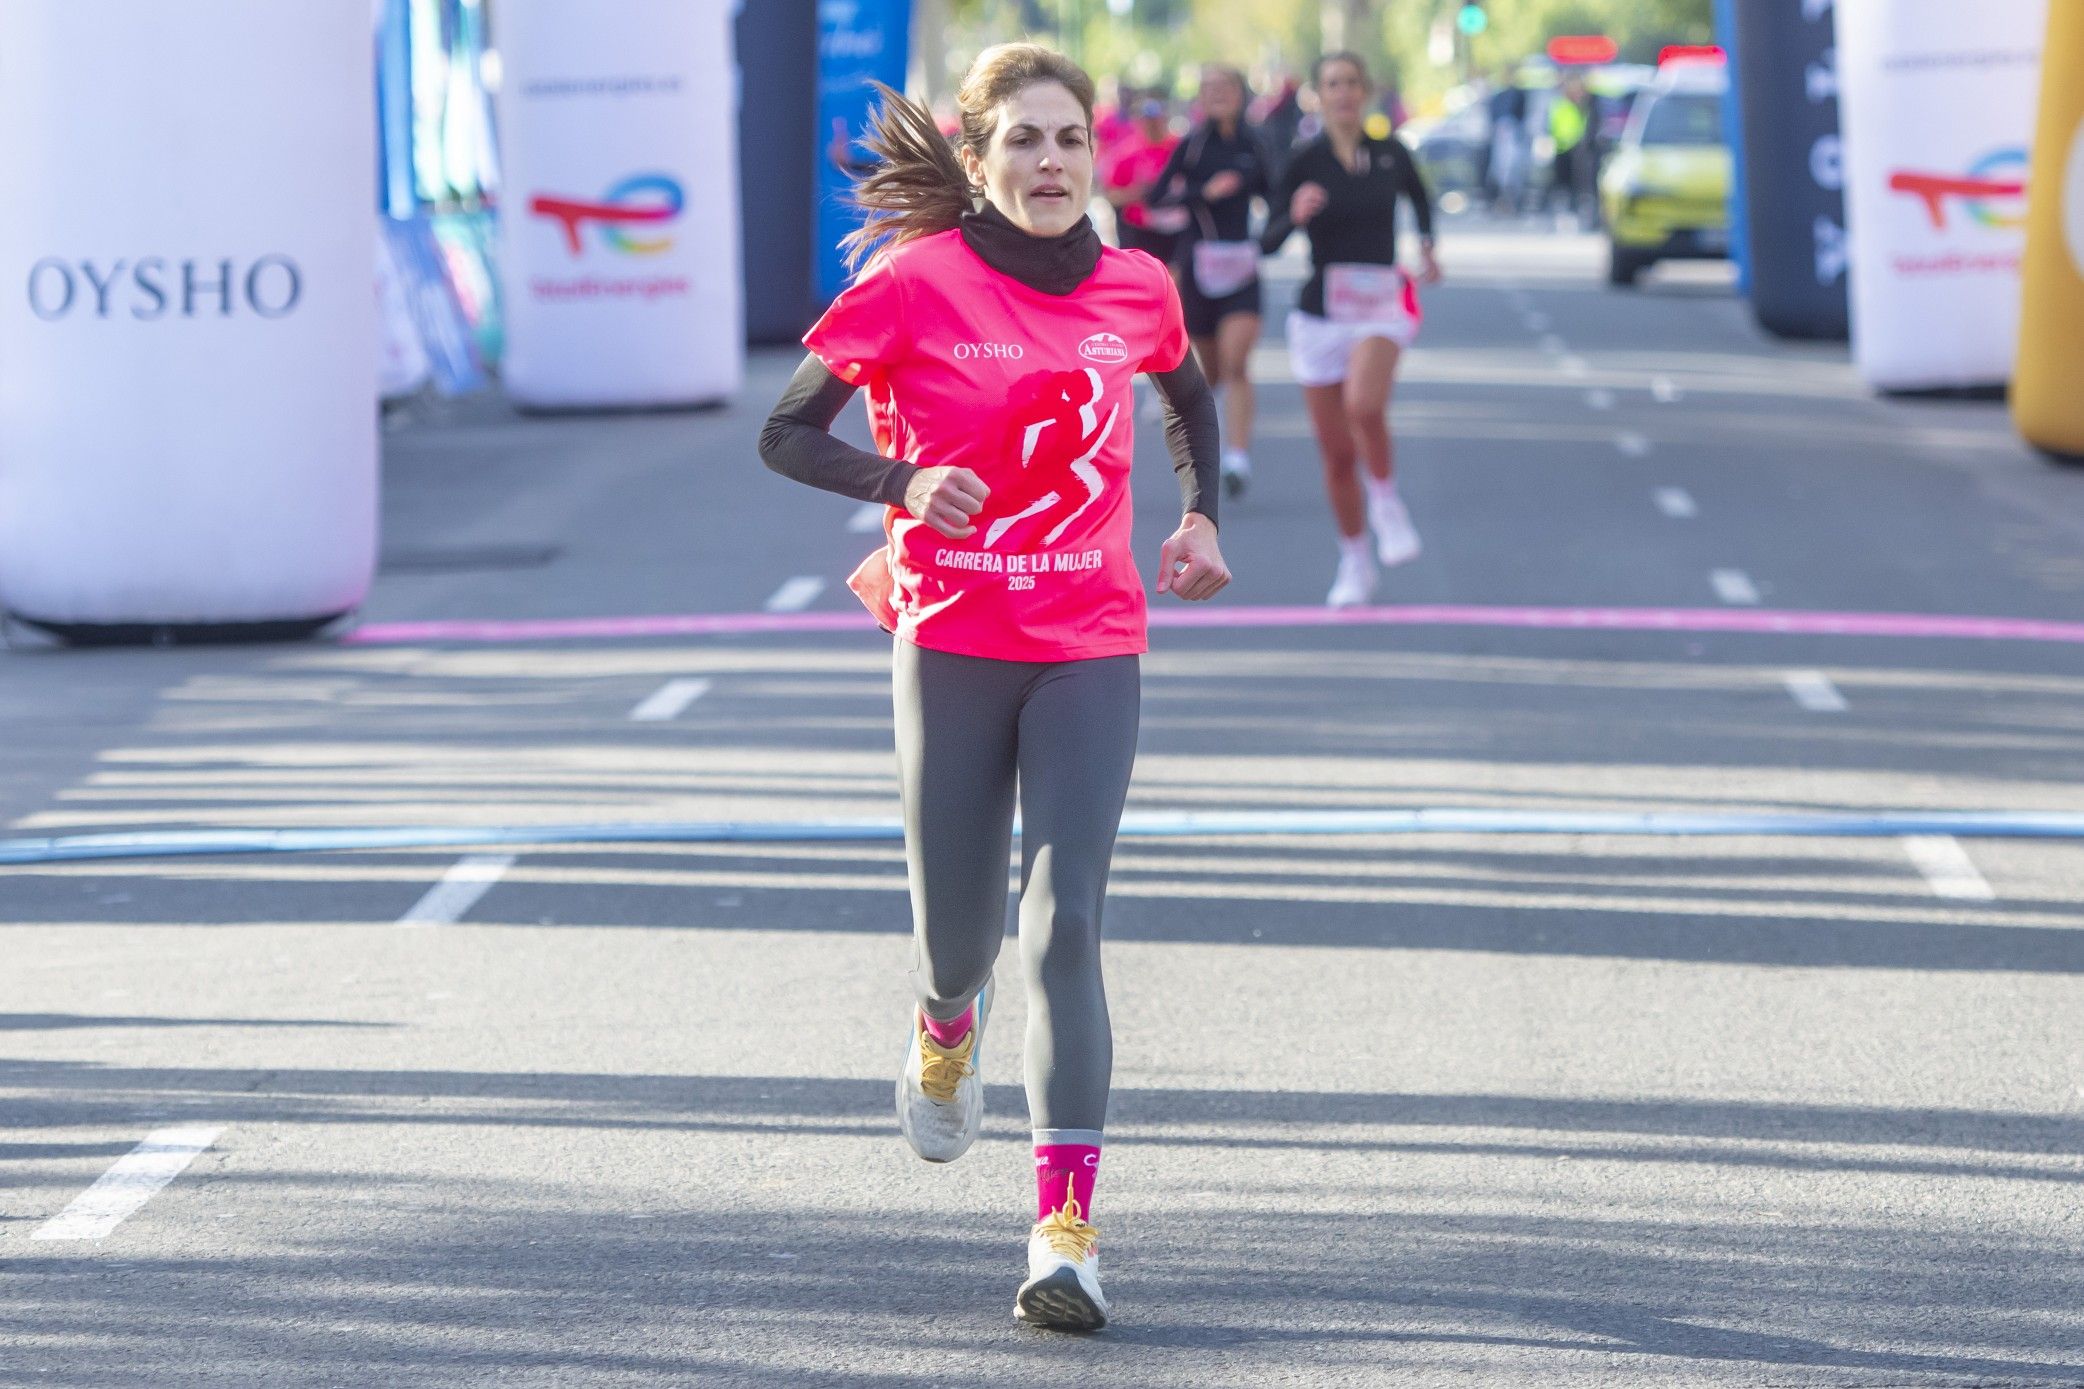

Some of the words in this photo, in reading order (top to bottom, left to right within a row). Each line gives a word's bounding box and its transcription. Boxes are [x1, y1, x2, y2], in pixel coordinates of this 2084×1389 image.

[28, 254, 303, 320] OYSHO
[953, 342, 1024, 360] OYSHO
[935, 548, 1003, 573] CARRERA
[1006, 554, 1027, 573] DE
[1031, 553, 1050, 573] LA
[1053, 549, 1103, 572] MUJER
[1007, 575, 1036, 591] 2025
